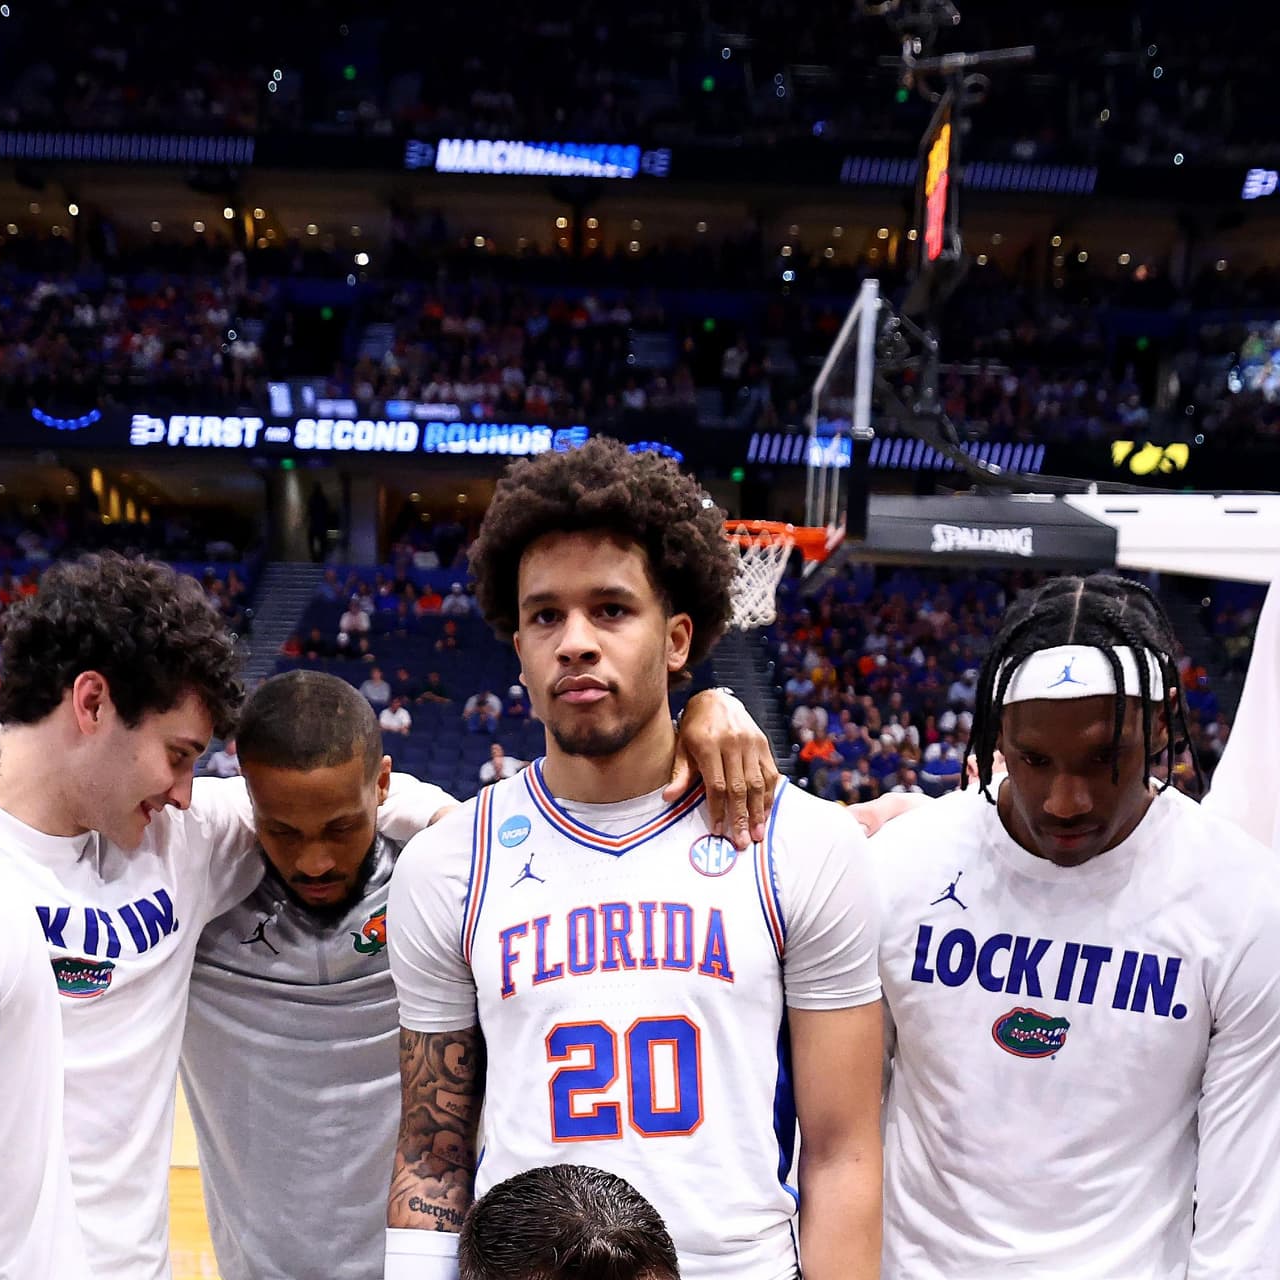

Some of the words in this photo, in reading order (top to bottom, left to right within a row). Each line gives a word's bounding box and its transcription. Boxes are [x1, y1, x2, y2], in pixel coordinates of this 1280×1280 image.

[167, 414, 264, 448] FIRST
[294, 418, 419, 452] SECOND
[423, 421, 554, 456] ROUNDS
[931, 523, 1034, 556] SPALDING
[693, 835, 737, 874] SEC
[117, 888, 179, 953] IN.
[499, 901, 735, 999] FLORIDA
[910, 924, 1053, 996] LOCK
[1055, 942, 1112, 1004] IT
[1112, 950, 1187, 1020] IN.
[545, 1015, 704, 1143] 20
